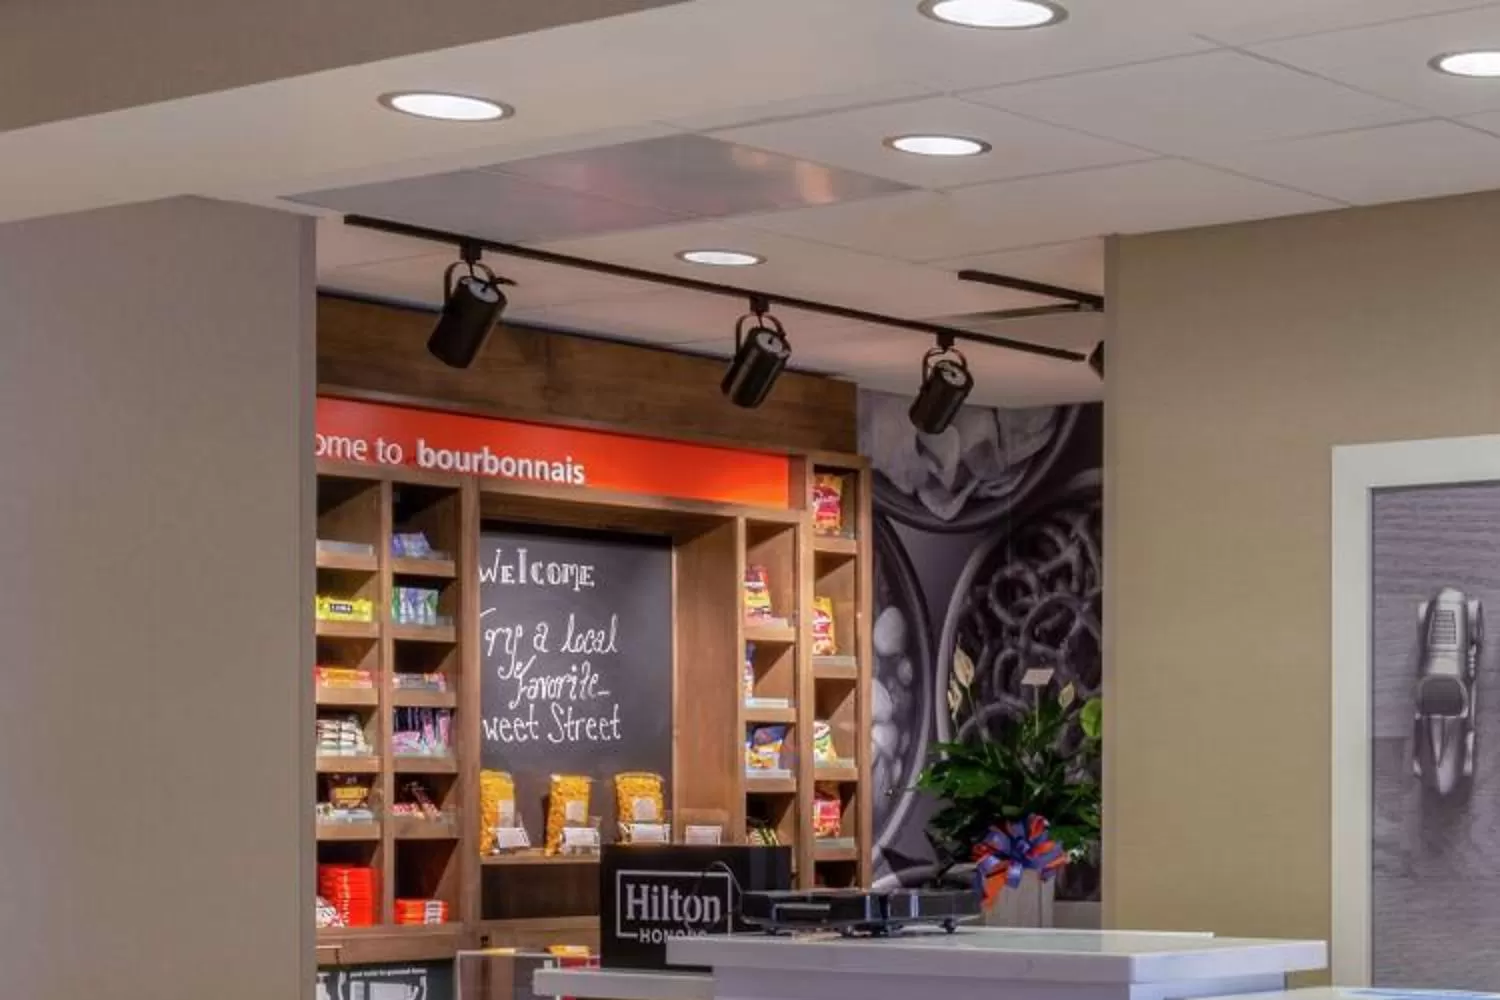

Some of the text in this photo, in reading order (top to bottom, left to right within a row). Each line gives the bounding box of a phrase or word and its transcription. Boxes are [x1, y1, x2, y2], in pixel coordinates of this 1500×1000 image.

[375, 436, 403, 465] to
[416, 438, 586, 485] bourbonnais
[480, 608, 619, 680] ry a local
[548, 702, 622, 743] Street
[625, 883, 721, 923] Hilton
